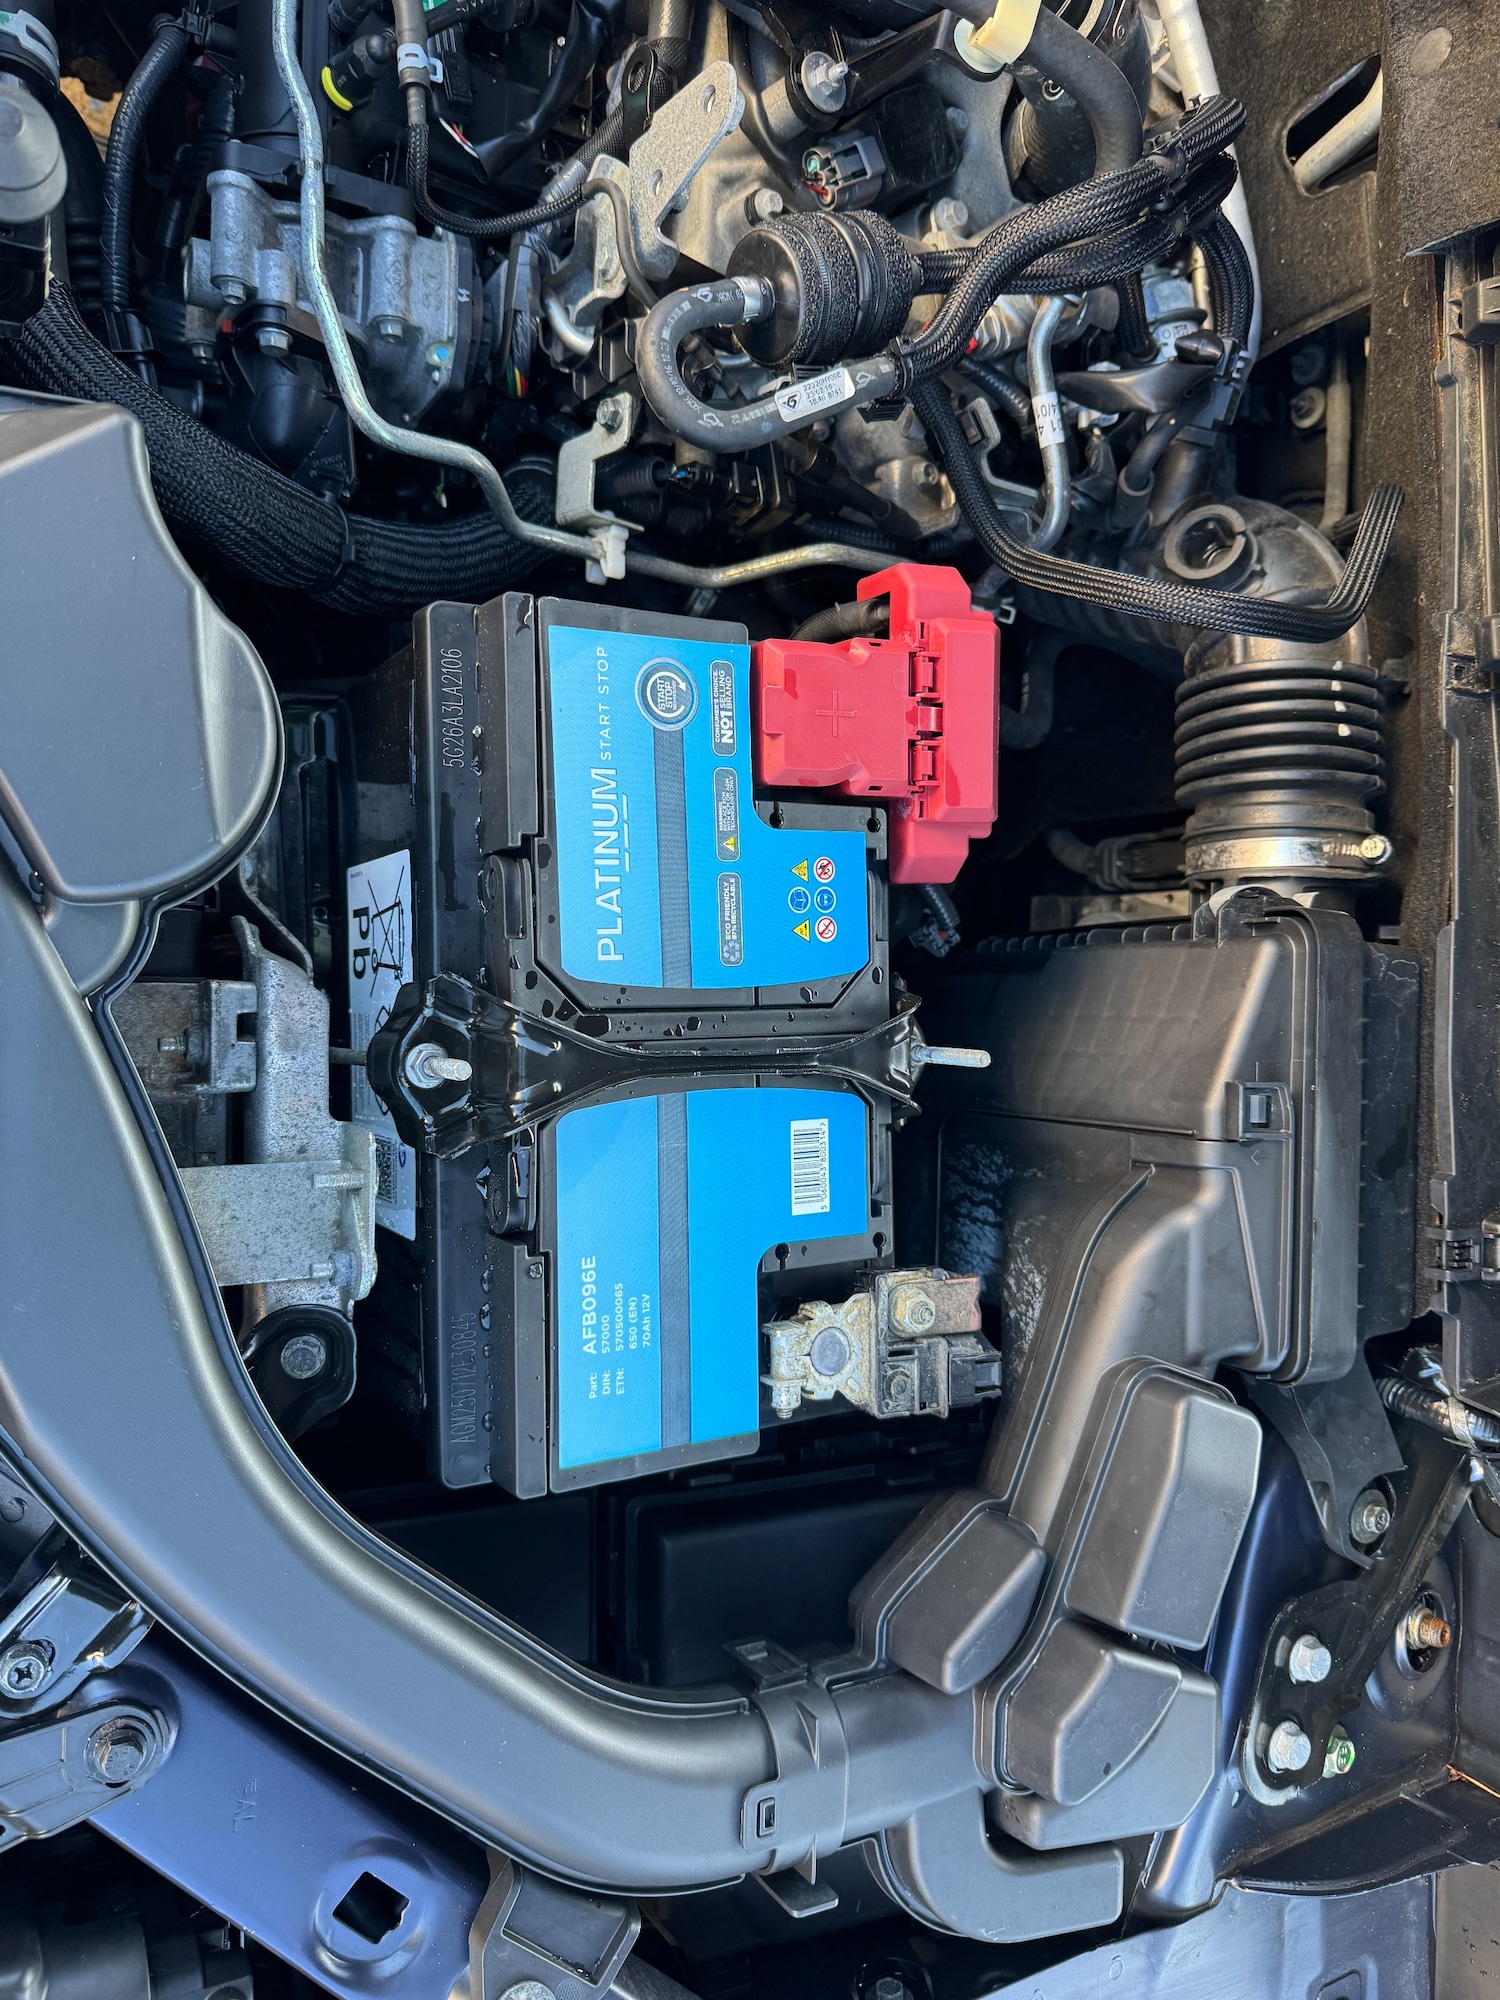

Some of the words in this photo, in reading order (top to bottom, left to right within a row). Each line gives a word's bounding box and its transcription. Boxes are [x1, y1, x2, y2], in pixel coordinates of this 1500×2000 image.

[595, 645, 610, 695] STOP
[656, 677, 666, 711] START
[664, 681, 673, 709] STOP
[718, 669, 726, 709] SELLING
[724, 675, 733, 709] BRAND
[440, 648, 465, 768] 5G26A3LA2106
[713, 697, 721, 743] CONSUMER'S
[600, 702, 613, 761] START
[591, 767, 624, 963] PLATINUM
[723, 881, 731, 922] FRIENDLY
[729, 877, 737, 925] RECYCLABLE
[724, 922, 732, 940] ECO
[730, 924, 738, 940] 97%
[818, 1130, 827, 1163] 800314
[819, 1166, 828, 1199] 060043
[580, 1255, 598, 1355] AFB096E
[614, 1283, 624, 1352] 570500065
[627, 1296, 639, 1324] (EN)
[641, 1293, 652, 1314] 12V
[600, 1314, 611, 1354] 57000
[628, 1326, 638, 1350] 650
[641, 1316, 652, 1348] 70Ah
[588, 1371, 599, 1399] Part:
[601, 1369, 612, 1395] DIN:
[615, 1367, 625, 1395] ETN:
